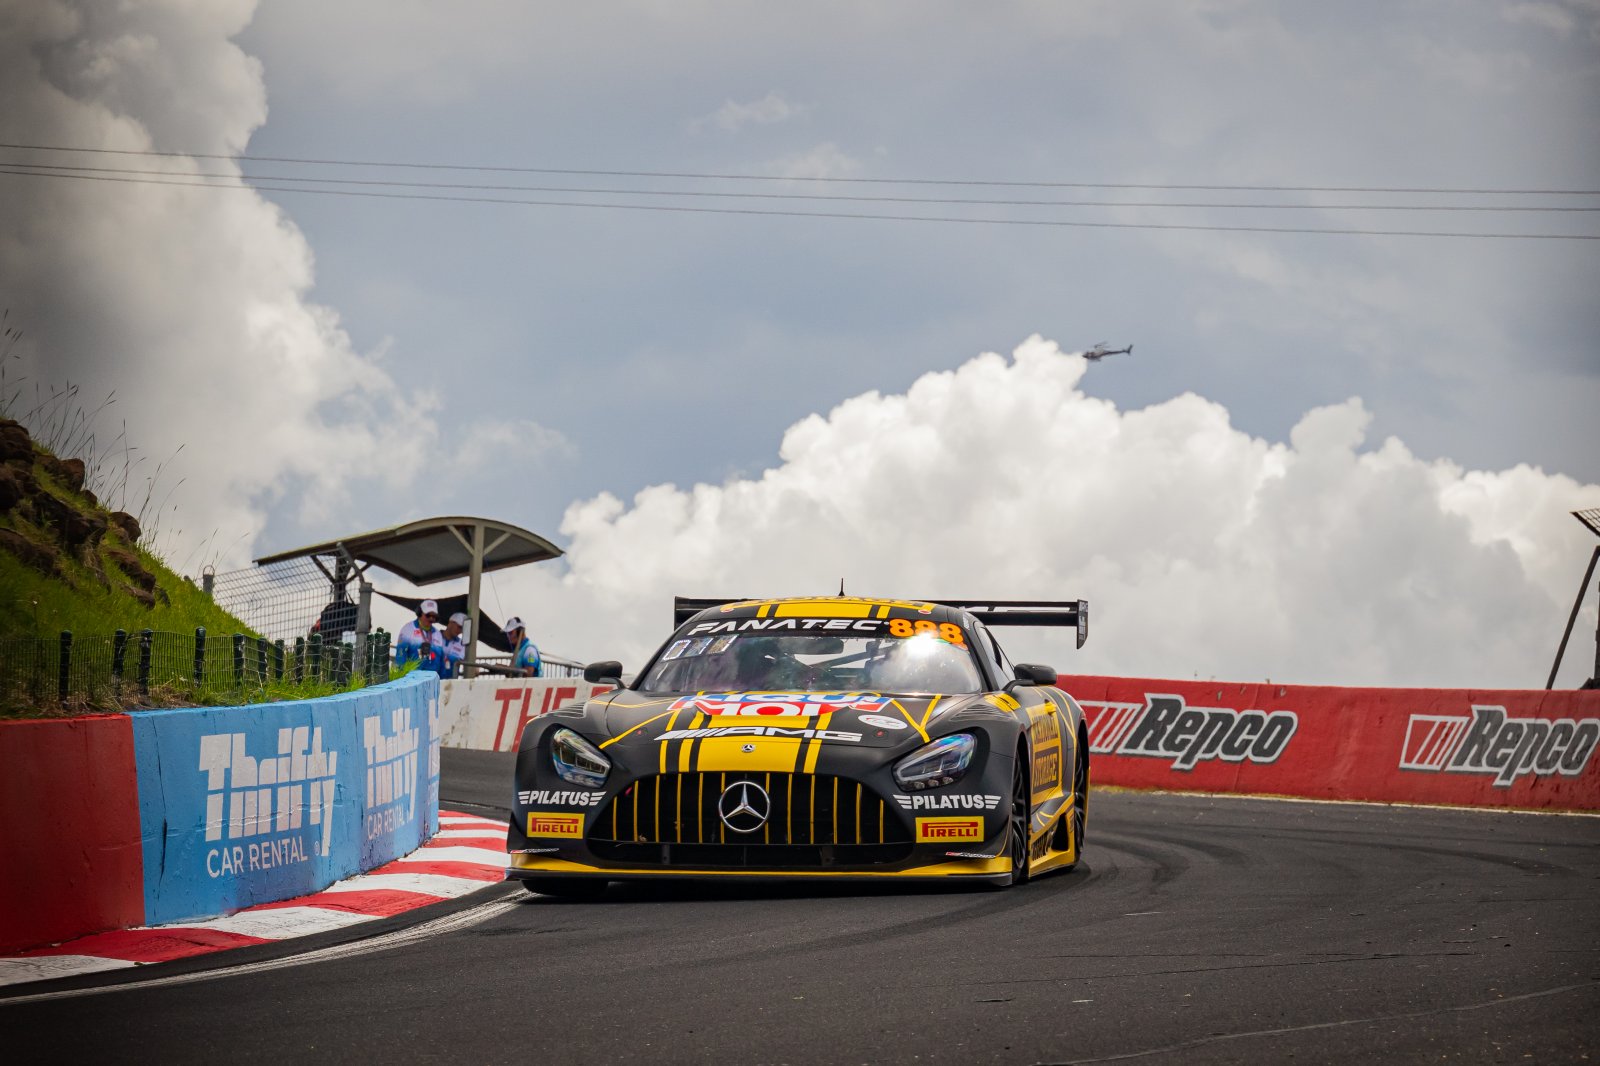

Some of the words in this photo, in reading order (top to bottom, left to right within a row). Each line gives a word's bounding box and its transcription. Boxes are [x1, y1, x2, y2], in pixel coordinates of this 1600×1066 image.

[687, 619, 883, 636] FANATEC
[890, 619, 964, 644] 888
[714, 727, 863, 742] AMG
[1117, 693, 1298, 769] Repco
[1445, 705, 1600, 786] Repco
[199, 726, 337, 857] Thrifty
[529, 791, 590, 806] PILATUS
[912, 795, 985, 809] PILATUS
[367, 811, 382, 840] CAR
[531, 817, 579, 833] PIRELLI
[922, 821, 978, 837] PIRELLI
[206, 845, 244, 878] CAR
[249, 836, 308, 871] RENTAL
